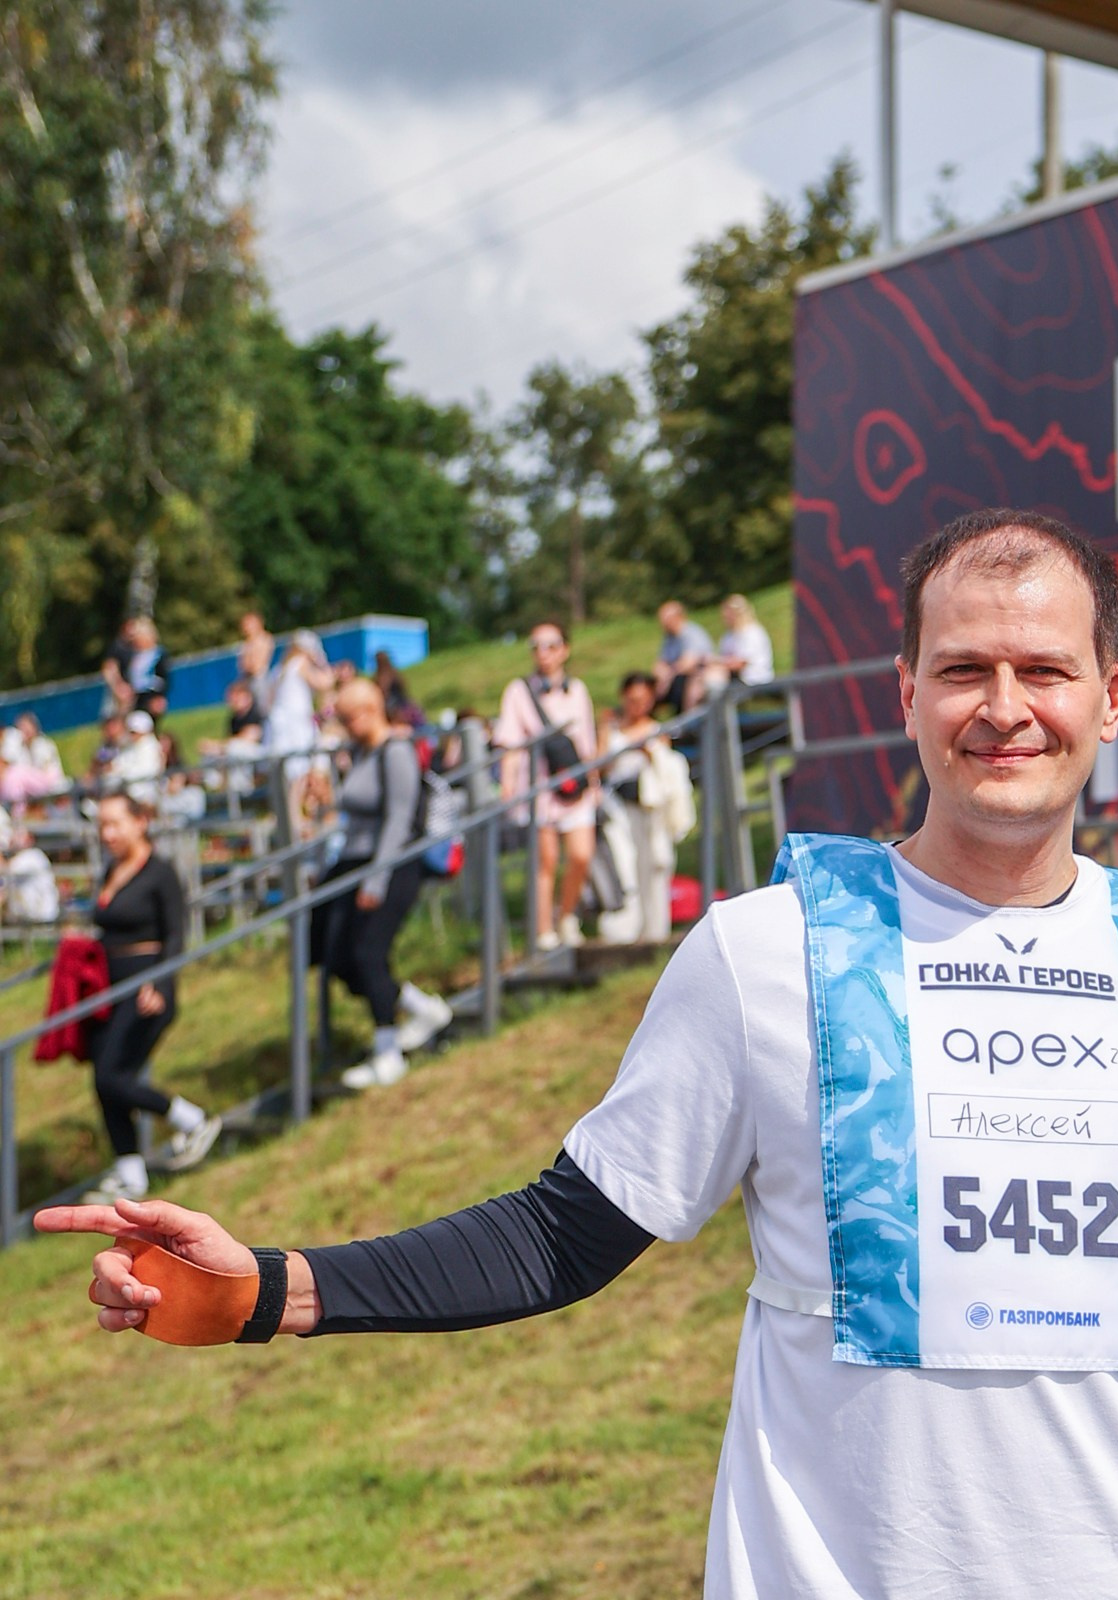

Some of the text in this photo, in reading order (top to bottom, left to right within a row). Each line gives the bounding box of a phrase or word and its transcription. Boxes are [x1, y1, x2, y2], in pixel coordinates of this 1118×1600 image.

[918, 962, 1115, 993] ГОНКА ГЕРОЕВ
[942, 1027, 1108, 1075] apex
[951, 1101, 1092, 1139] Алексей
[999, 1308, 1101, 1328] ГАЗПРОМБАНК
